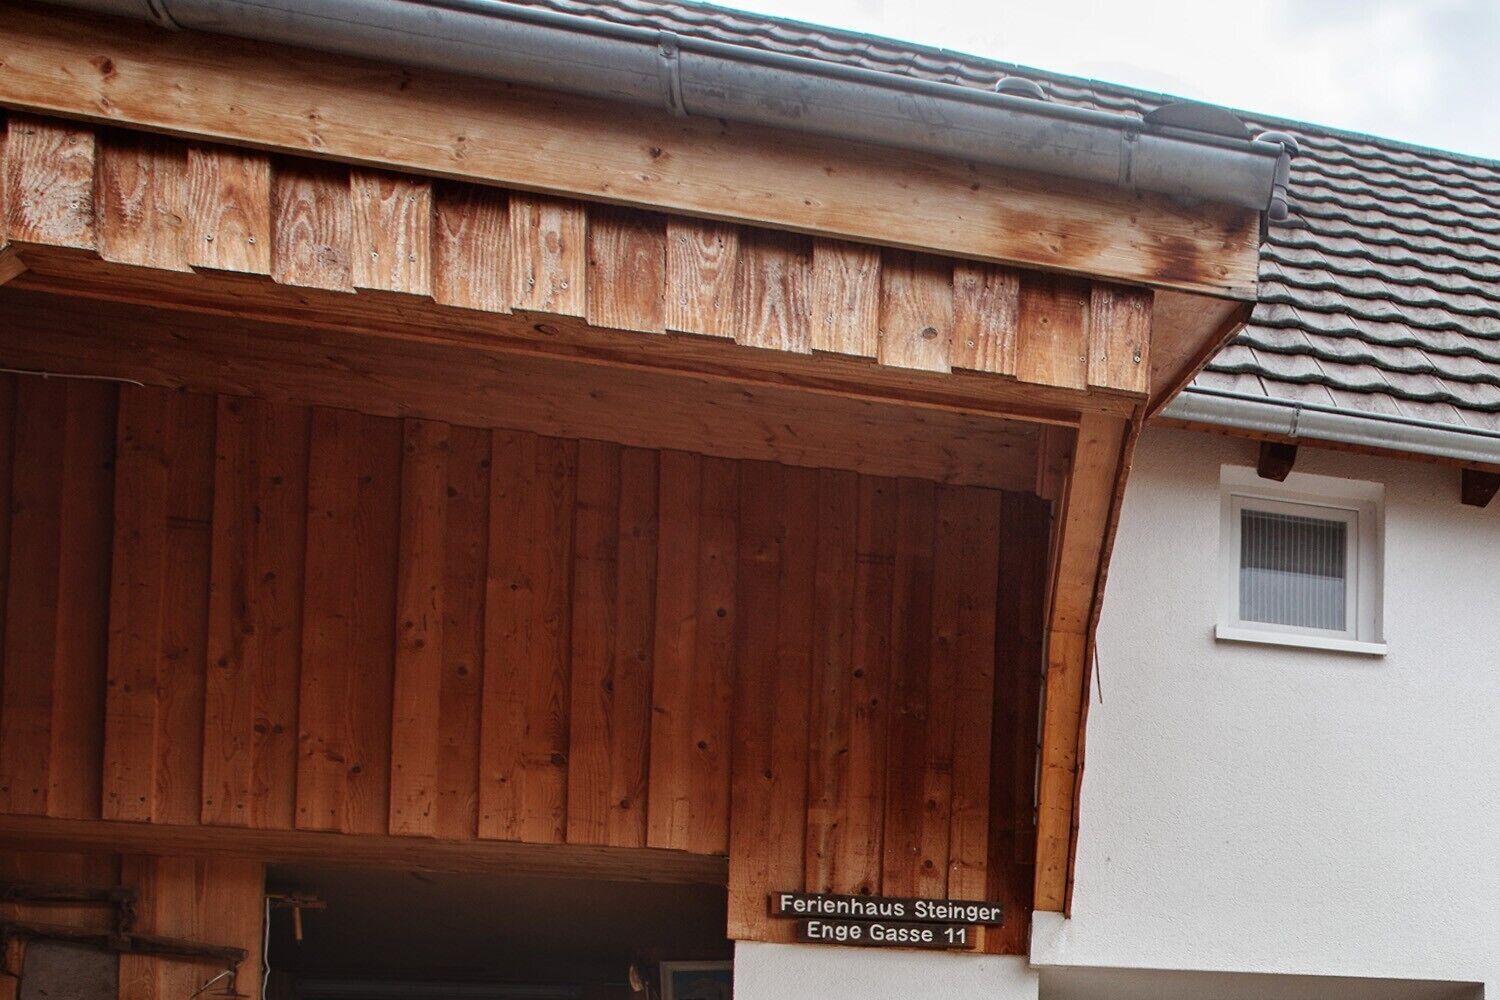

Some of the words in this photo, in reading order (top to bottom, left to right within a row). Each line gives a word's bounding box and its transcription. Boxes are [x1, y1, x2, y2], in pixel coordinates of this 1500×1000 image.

[781, 894, 905, 916] Ferienhaus
[914, 901, 1000, 921] Steinger
[807, 921, 861, 941] Enge
[869, 924, 933, 942] Gasse
[944, 928, 966, 944] 11
